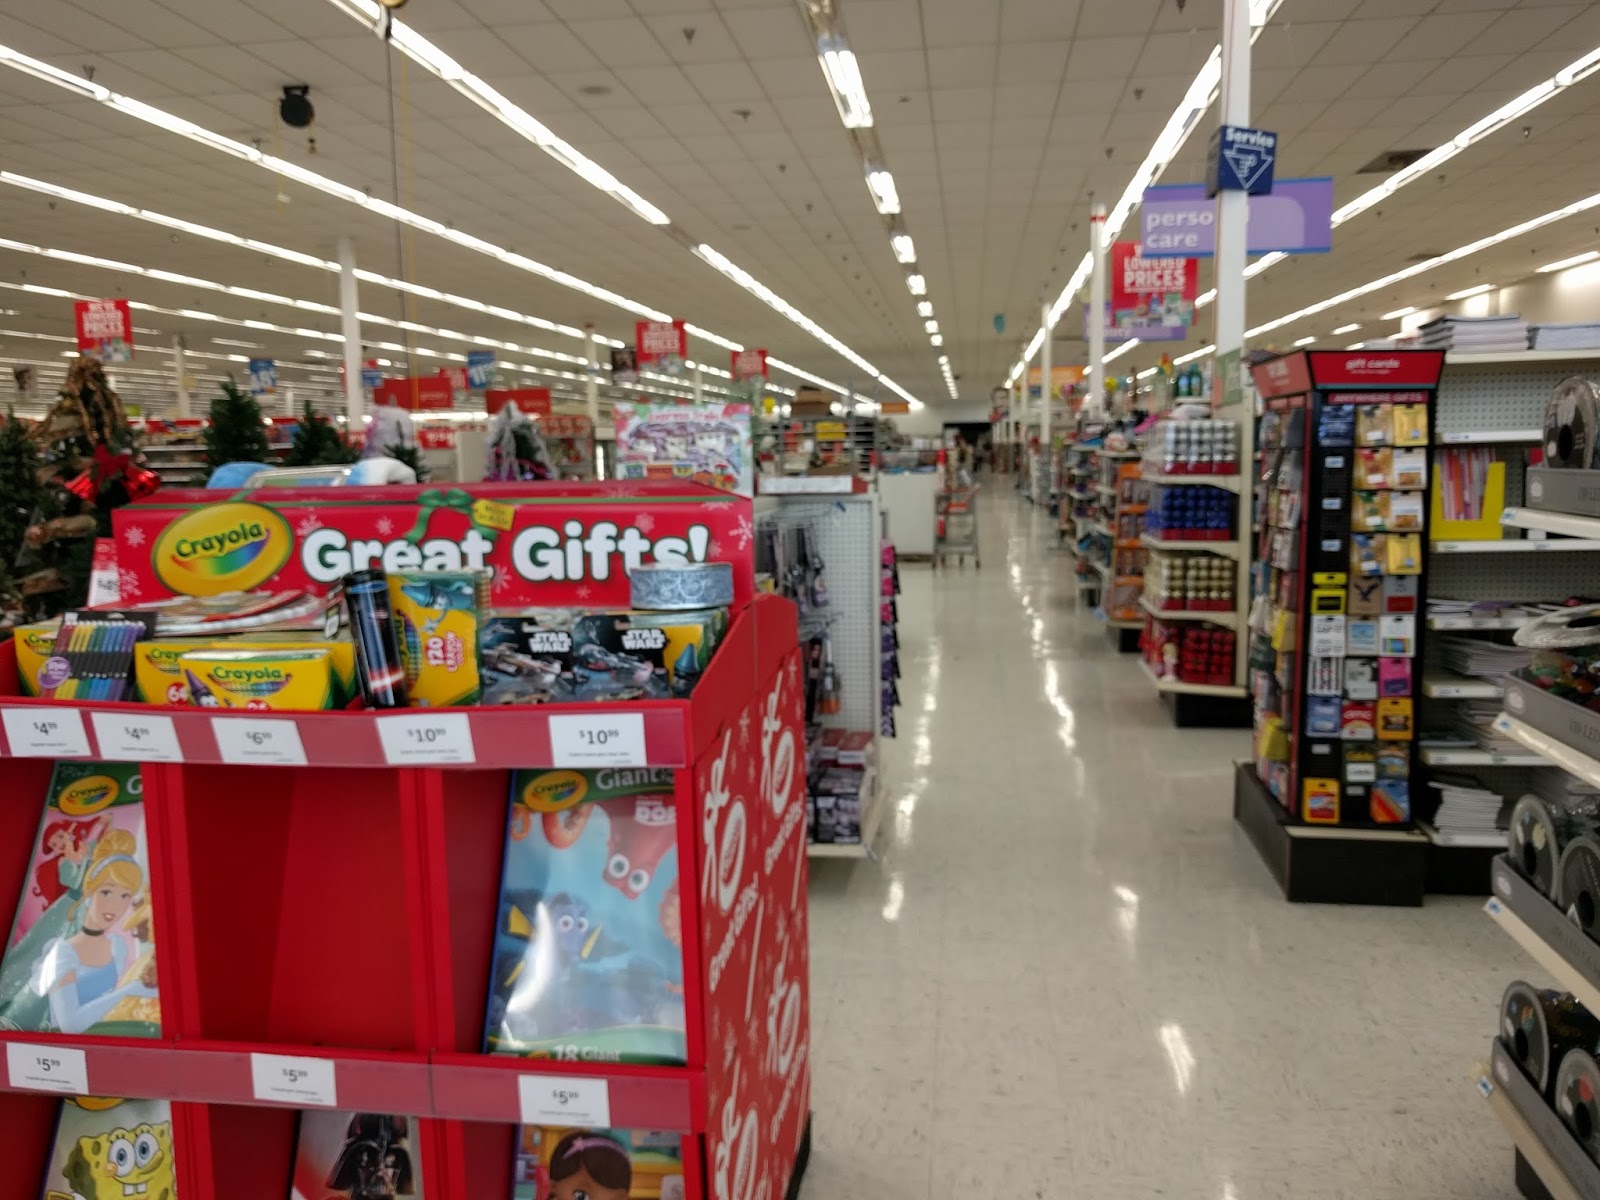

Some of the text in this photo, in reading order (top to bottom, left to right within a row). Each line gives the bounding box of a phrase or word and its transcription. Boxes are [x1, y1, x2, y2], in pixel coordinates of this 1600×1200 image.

[1226, 128, 1275, 148] Service
[1146, 211, 1214, 232] perso
[1146, 233, 1199, 248] care
[1124, 270, 1186, 287] PRICES
[176, 523, 263, 558] Crayola
[301, 519, 710, 582] Great Gifts!
[529, 631, 570, 643] STAR
[622, 628, 664, 640] STAR
[530, 641, 572, 653] WARS
[623, 638, 666, 650] WARS
[213, 666, 283, 682] Crayola
[595, 767, 659, 790] Giant
